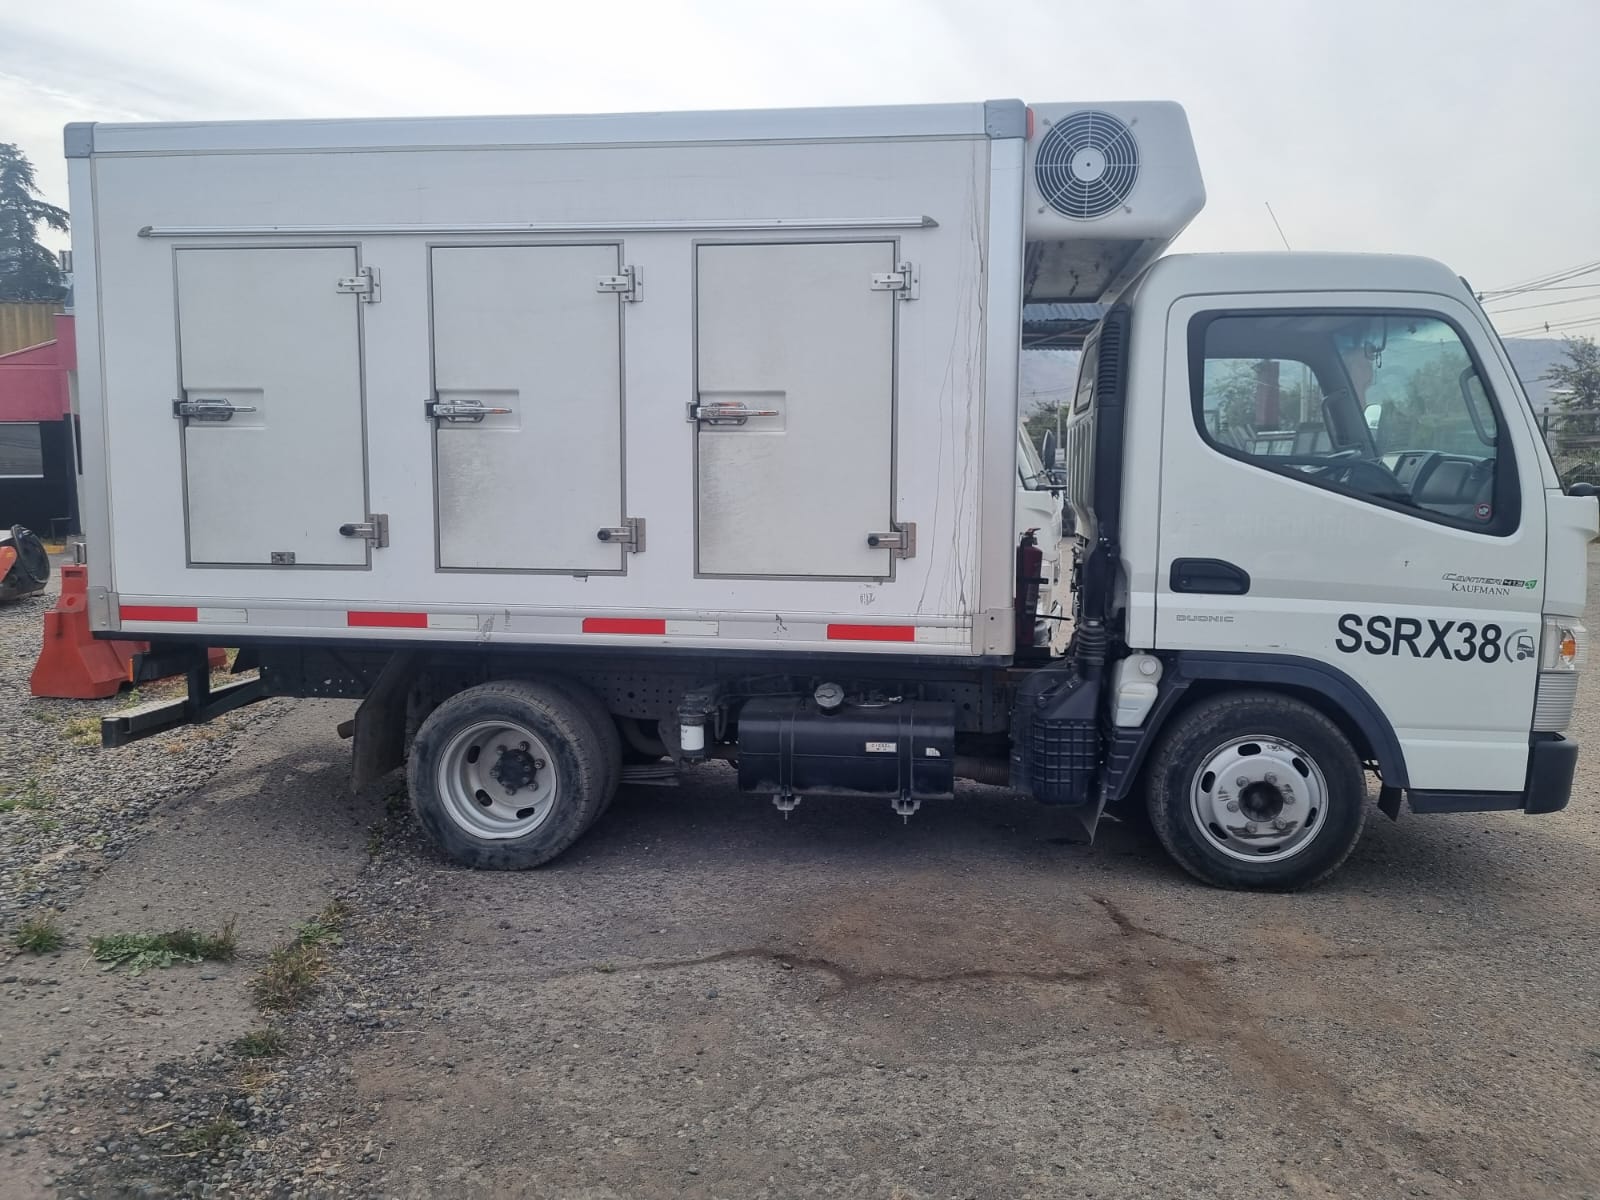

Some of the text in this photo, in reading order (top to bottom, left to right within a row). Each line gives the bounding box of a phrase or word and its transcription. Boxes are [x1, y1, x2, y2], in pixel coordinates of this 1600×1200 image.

[1451, 583, 1510, 596] KAUFMANN
[1175, 614, 1234, 623] DUONIC
[1335, 613, 1502, 663] SSRX38
